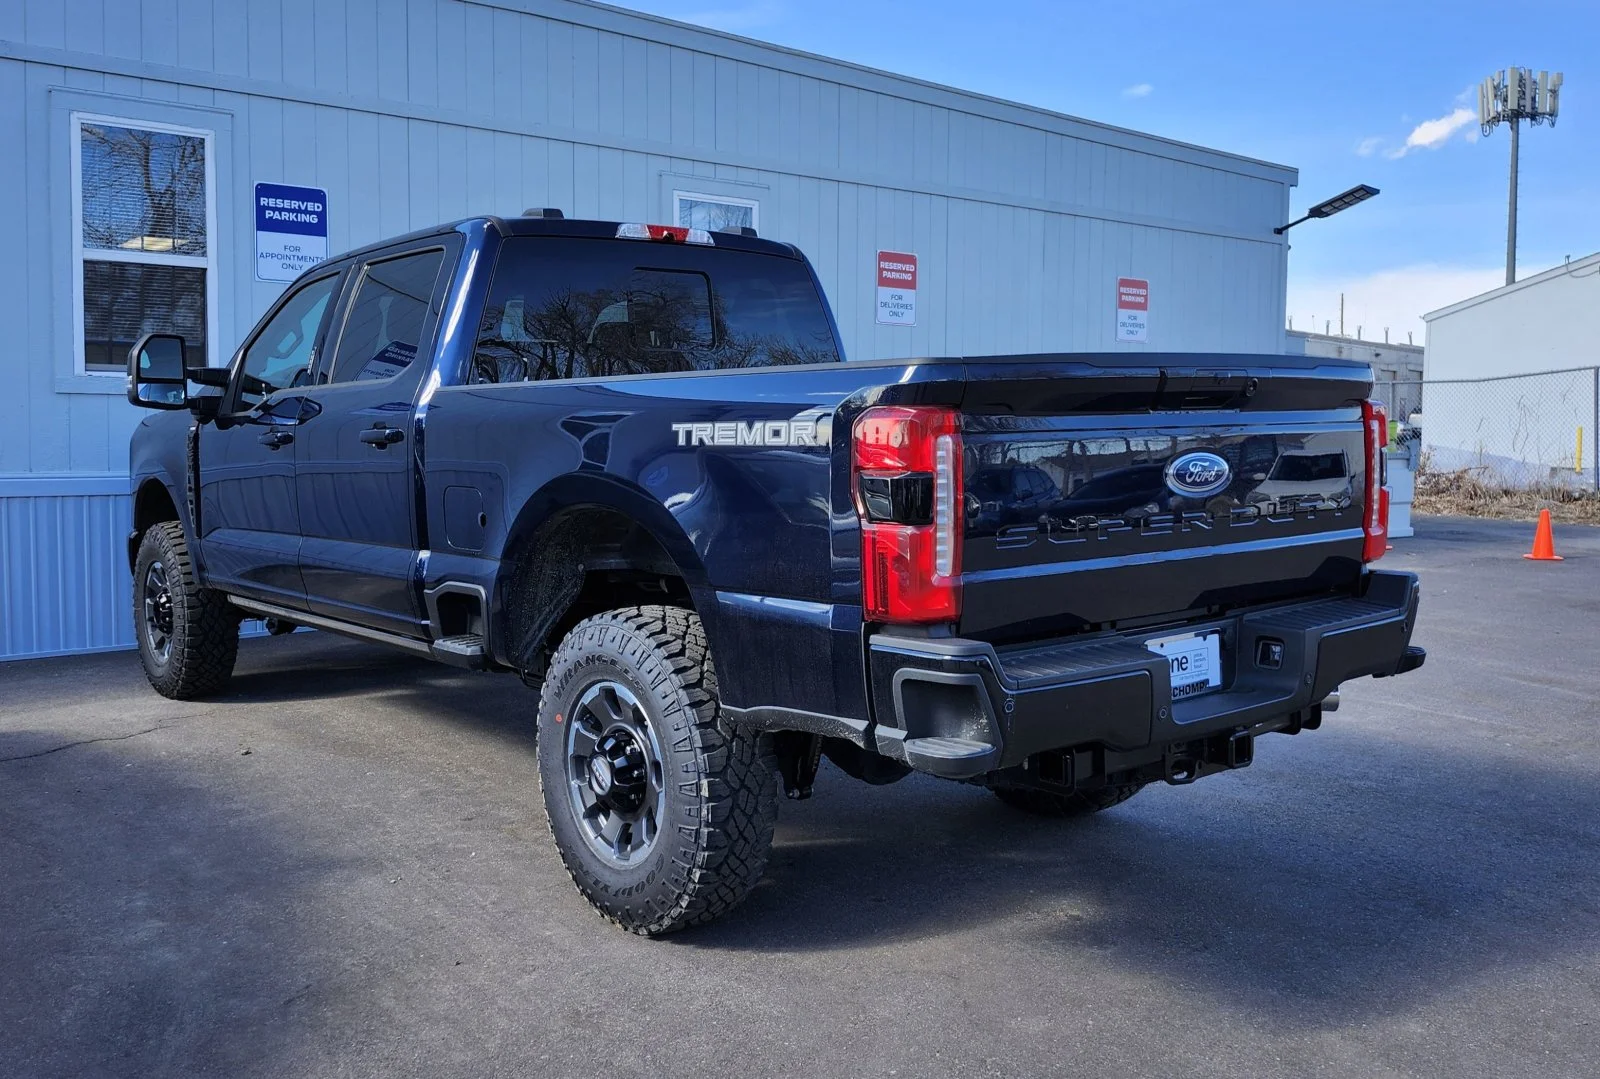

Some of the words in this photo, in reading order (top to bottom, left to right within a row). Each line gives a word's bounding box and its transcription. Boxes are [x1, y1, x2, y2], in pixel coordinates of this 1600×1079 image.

[260, 197, 323, 212] RESERVED
[265, 209, 319, 224] PARKING
[283, 245, 301, 253] FOR
[281, 262, 304, 271] ONLY
[880, 261, 915, 272] RESERVED
[882, 271, 913, 281] PARKING
[1120, 286, 1147, 296] RESERVED
[890, 294, 903, 302] FOR
[1121, 294, 1145, 303] PARKING
[880, 301, 913, 311] DELIVERIES
[888, 310, 905, 318] ONLY
[671, 420, 818, 447] TREMOR
[1186, 461, 1218, 483] Ford
[996, 509, 1214, 549] SUPER
[1230, 494, 1351, 527] DUTY
[1170, 655, 1189, 673] ne
[1172, 681, 1205, 698] CHOMP
